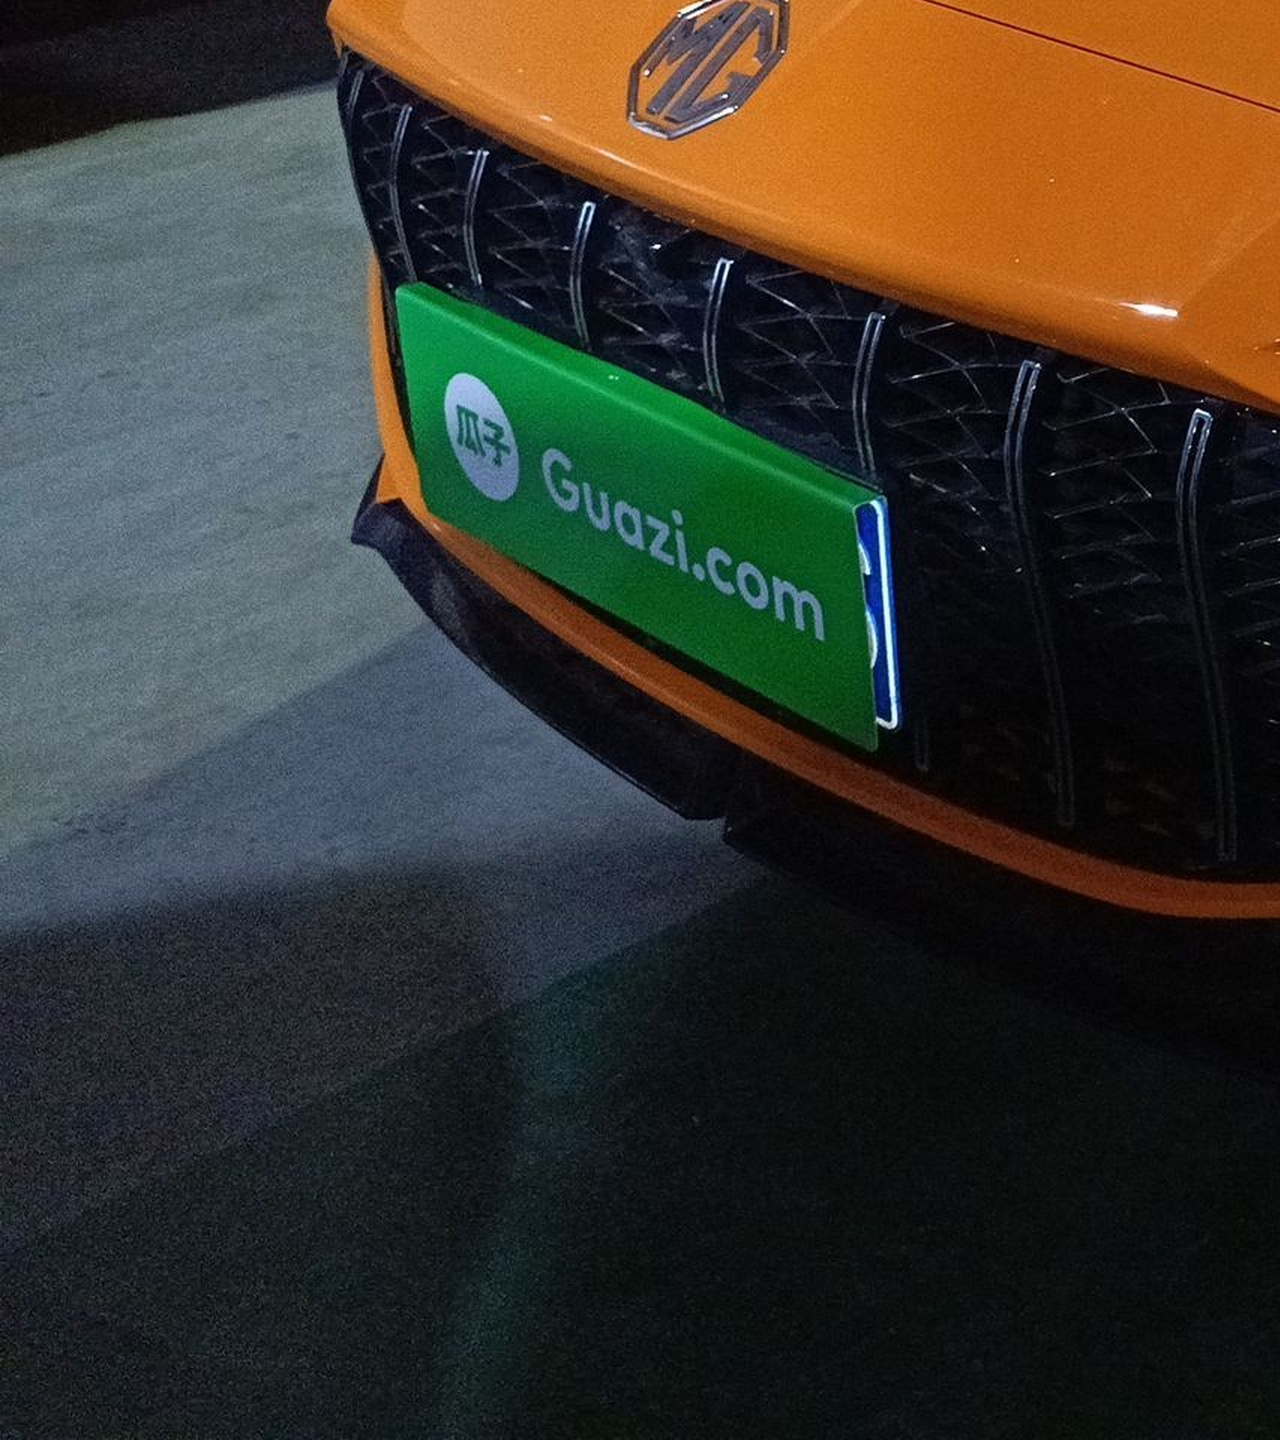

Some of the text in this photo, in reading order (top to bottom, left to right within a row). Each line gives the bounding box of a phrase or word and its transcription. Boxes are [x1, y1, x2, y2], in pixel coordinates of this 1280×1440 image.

[643, 0, 776, 124] MG
[455, 403, 826, 642] 瓜子 Guazi.com
